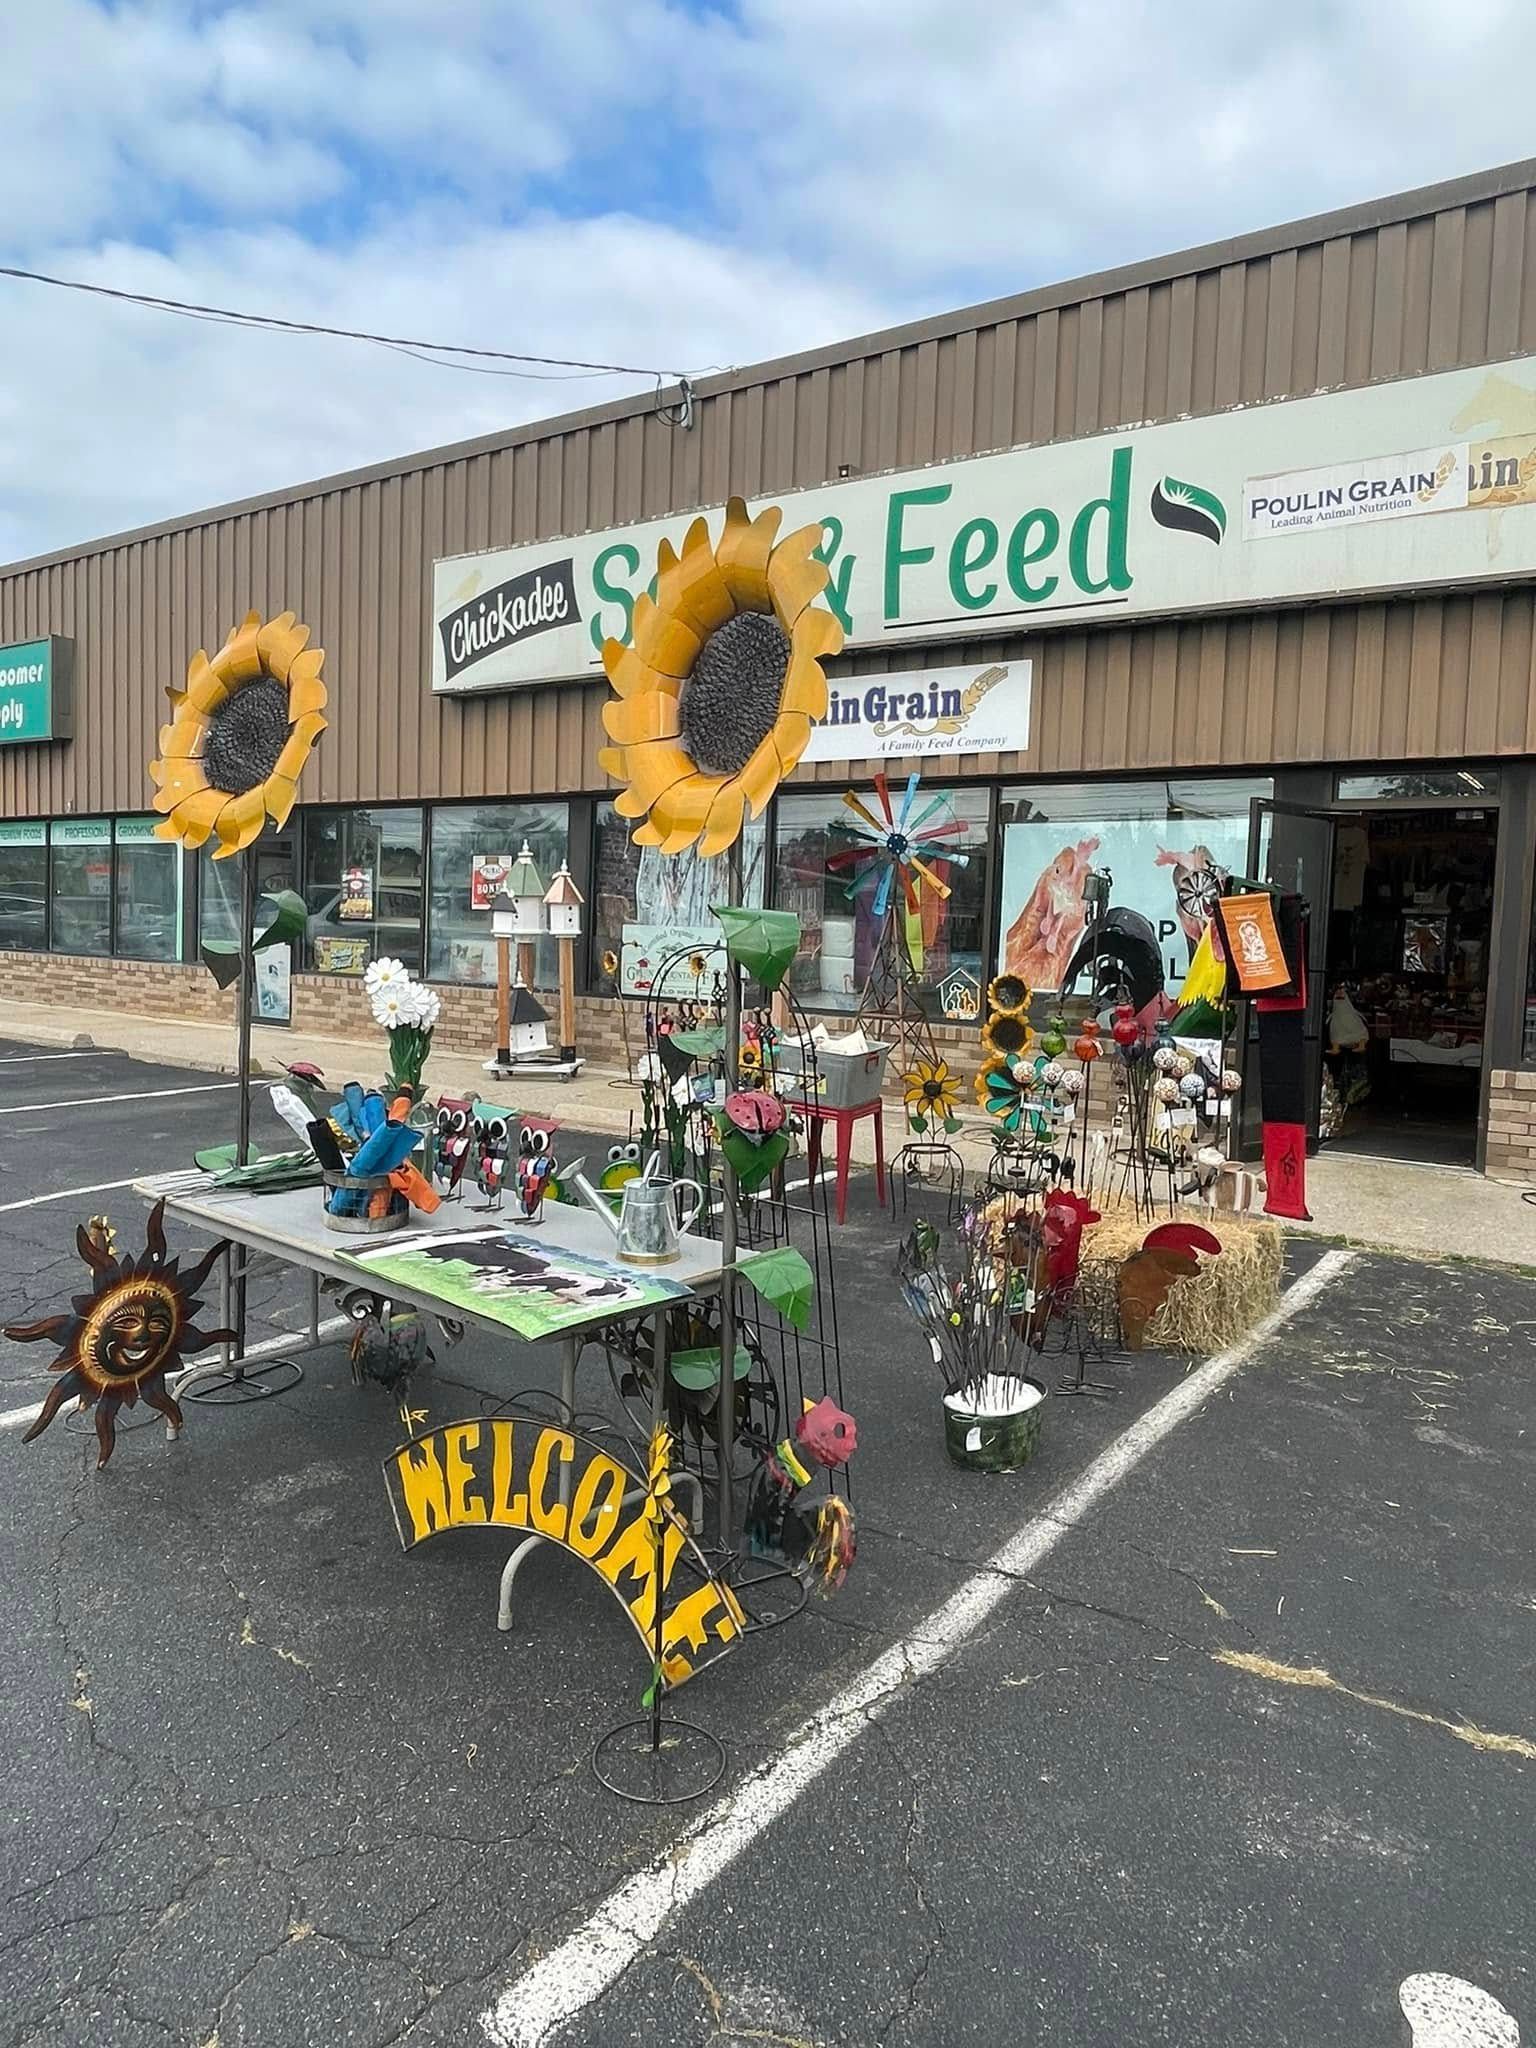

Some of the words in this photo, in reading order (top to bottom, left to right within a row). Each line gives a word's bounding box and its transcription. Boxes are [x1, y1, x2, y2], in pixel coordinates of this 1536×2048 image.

[1250, 487, 1344, 519] POULIN
[1349, 471, 1436, 502] GRAIN
[1270, 514, 1313, 529] Leading
[1316, 505, 1356, 521] Animal
[1359, 498, 1412, 516] Nutrition
[884, 446, 1134, 620] Feed
[450, 575, 569, 664] Chickadee
[0, 698, 24, 728] ply
[877, 742, 887, 751] A
[888, 739, 926, 751] Family
[927, 737, 954, 749] Feed
[957, 736, 1009, 748] Company
[397, 1420, 737, 1688] WELCOME
